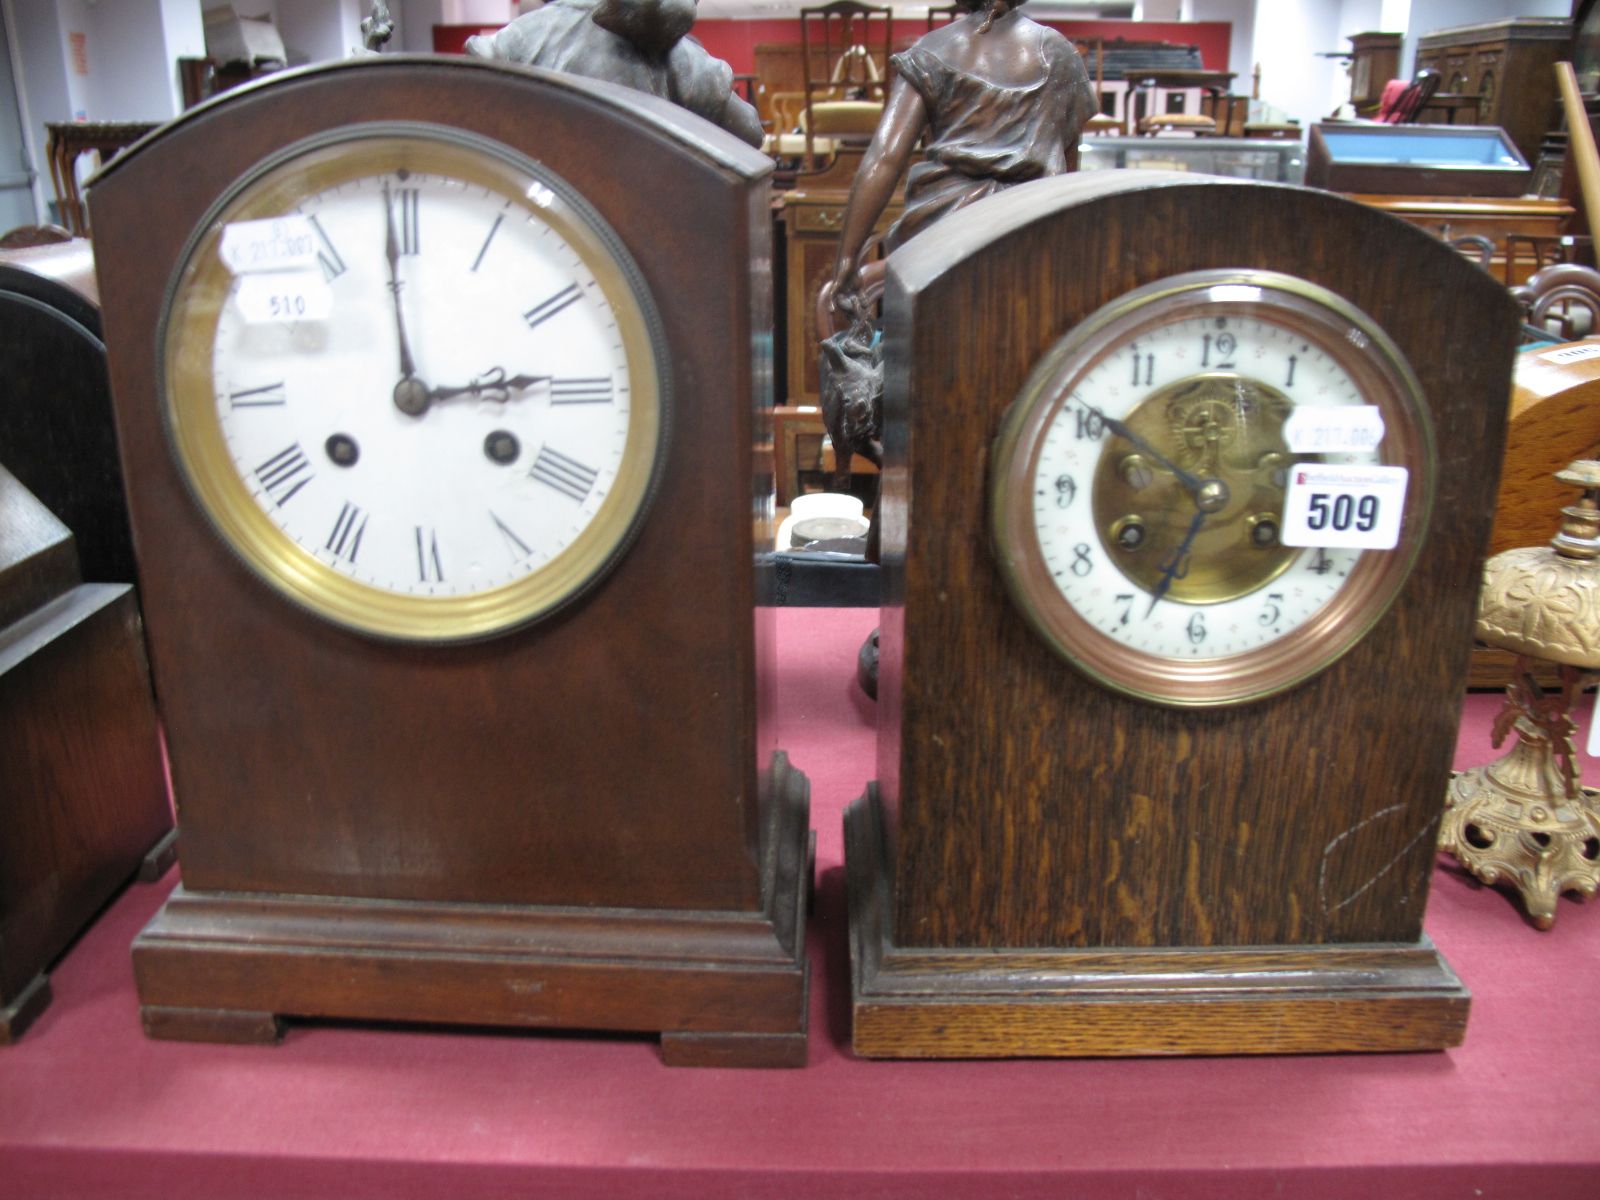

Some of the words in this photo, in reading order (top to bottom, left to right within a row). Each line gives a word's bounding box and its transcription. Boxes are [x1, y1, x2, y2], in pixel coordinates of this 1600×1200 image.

[269, 295, 306, 317] 510
[522, 281, 584, 329] II
[1200, 333, 1238, 369] 12
[1131, 352, 1155, 387] 11
[1285, 354, 1297, 388] 1
[549, 376, 613, 406] III
[1076, 409, 1104, 440] 10
[1055, 474, 1078, 509] 9
[1307, 492, 1380, 532] 509
[1070, 543, 1093, 577] 8
[1305, 547, 1333, 576] 4
[1115, 594, 1134, 627] 7
[1259, 594, 1284, 627] 5
[1186, 612, 1207, 643] 6
